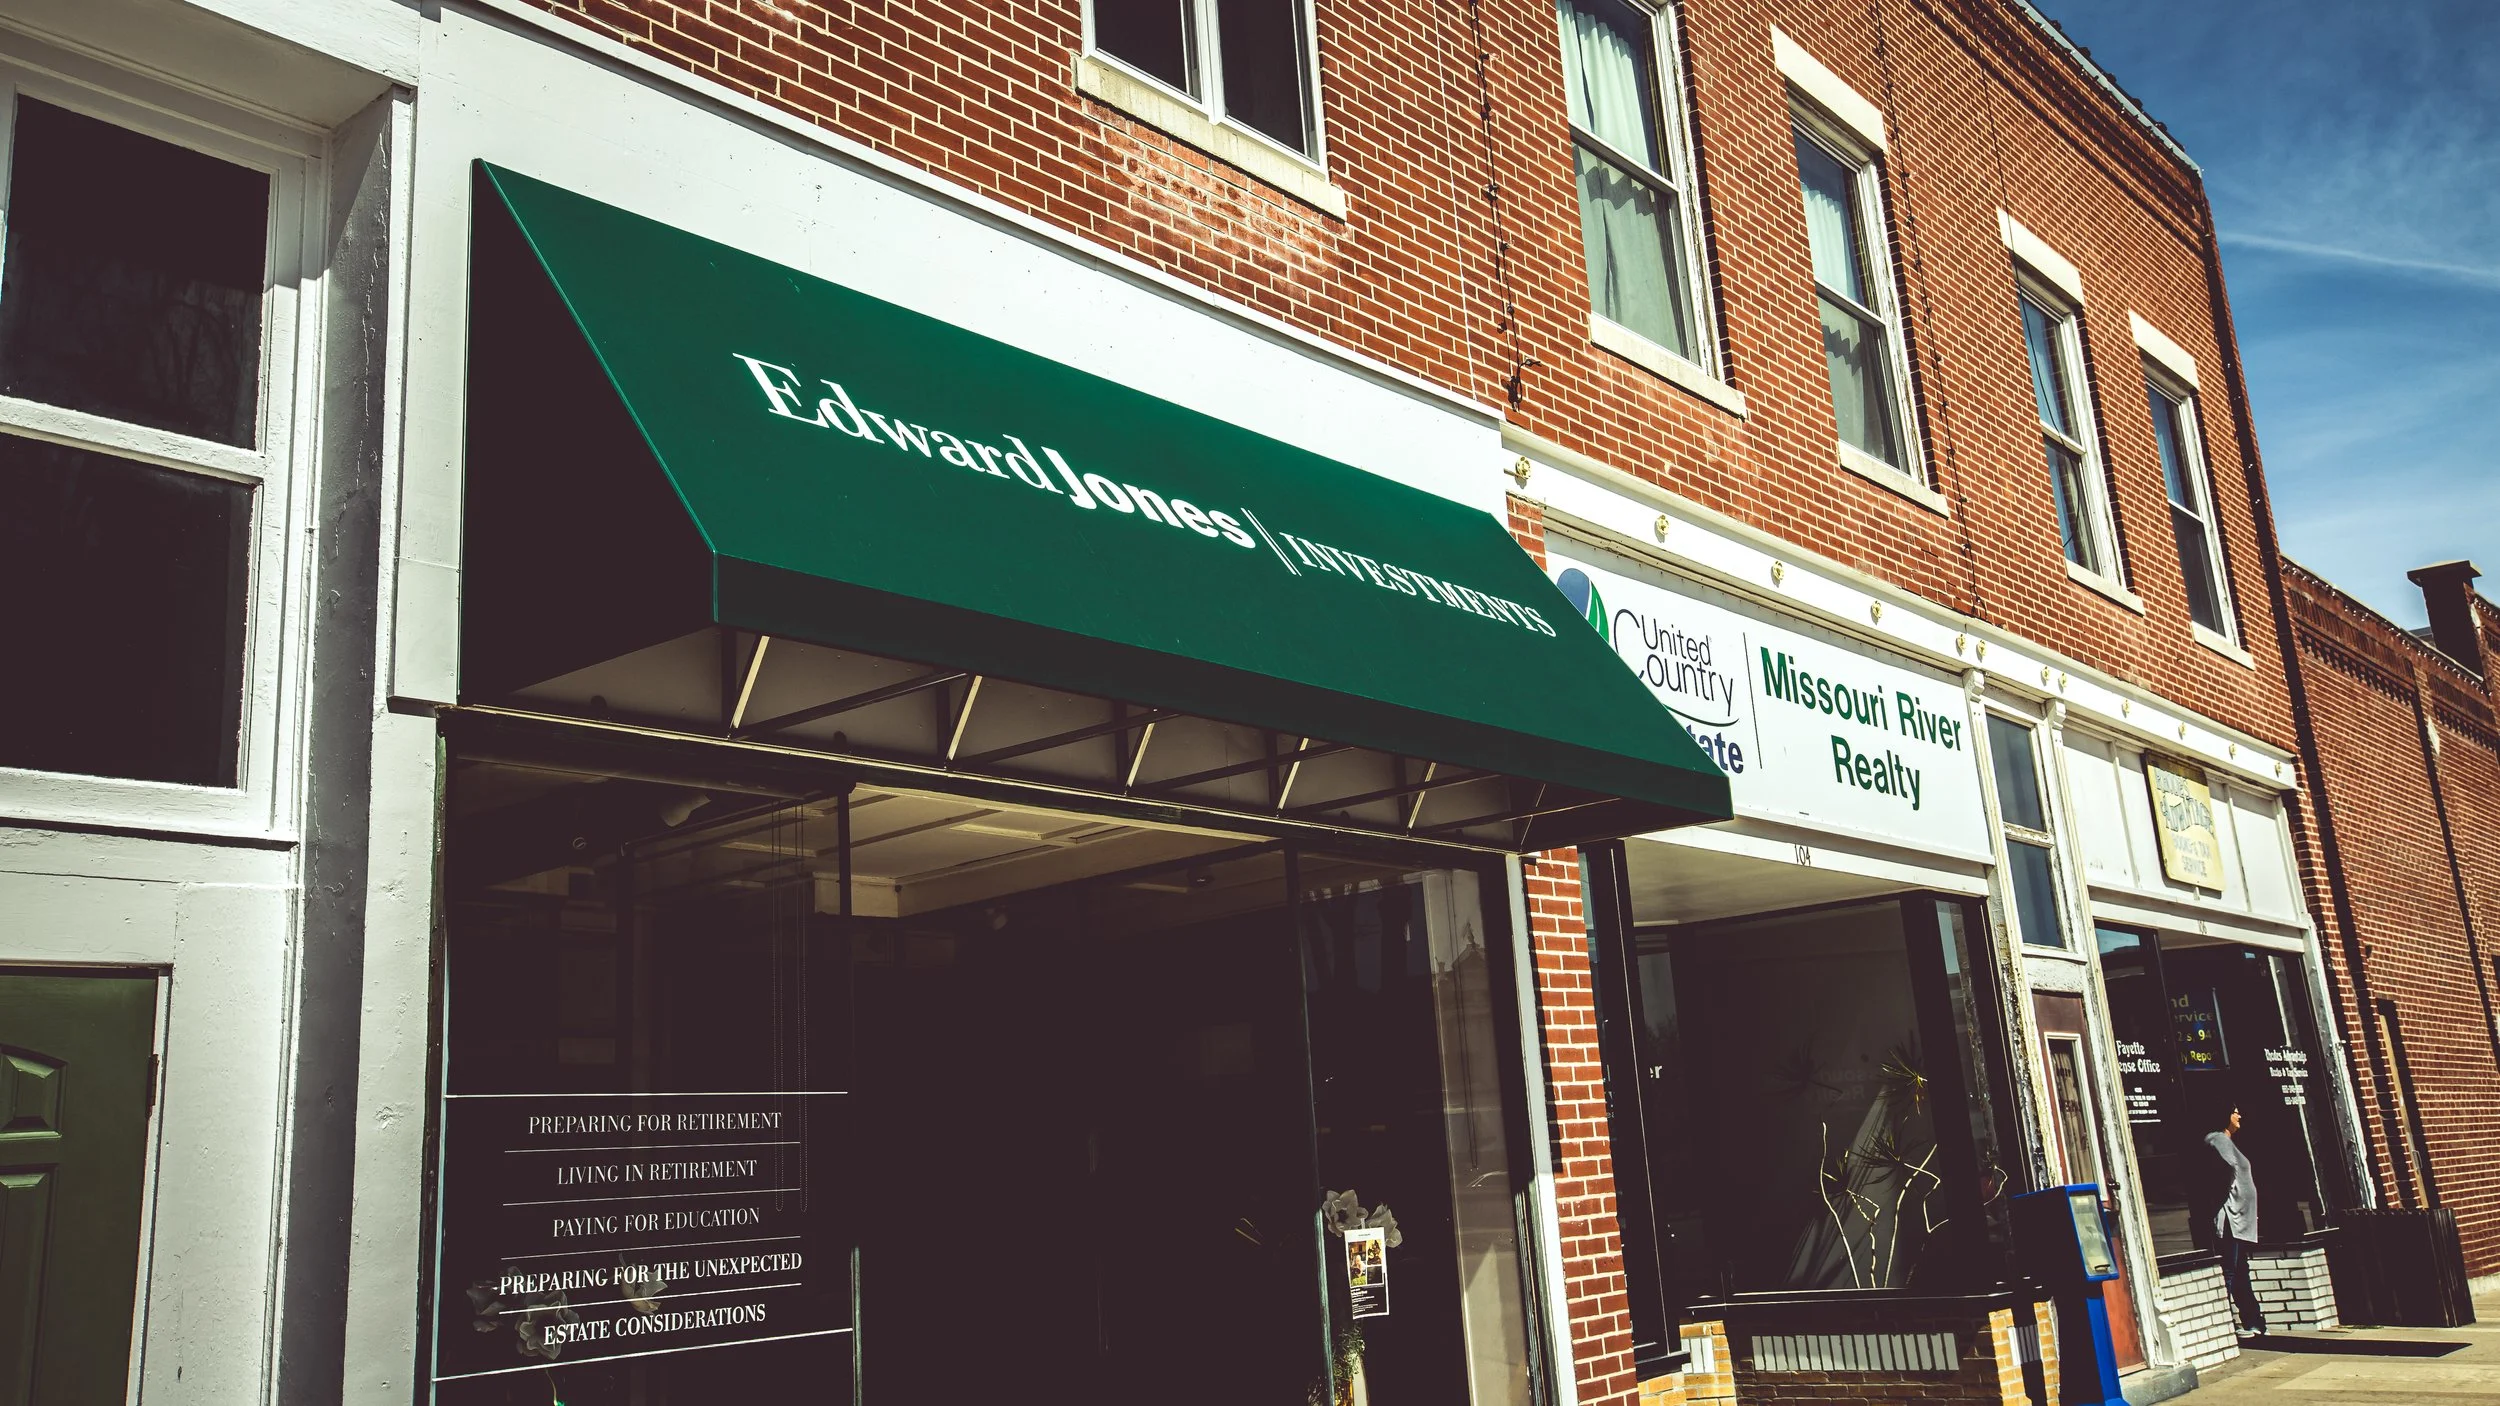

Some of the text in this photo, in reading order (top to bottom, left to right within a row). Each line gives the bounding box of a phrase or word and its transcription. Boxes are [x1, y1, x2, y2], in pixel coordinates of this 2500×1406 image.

[1278, 531, 1557, 637] INVESTMENTS
[1641, 614, 1712, 667] United
[1760, 646, 1961, 751] Missouri River
[1830, 734, 1920, 811] Realty
[1794, 843, 1811, 867] 104
[2115, 1040, 2146, 1058] Fayette
[2137, 1058, 2161, 1073] Office
[528, 1111, 782, 1135] PREPARING FOR RETIREMENT
[557, 1159, 758, 1186] LIVING IN RETIREMENT
[552, 1207, 761, 1238] PAYING FOR EDUCATION
[499, 1252, 802, 1296] PREPARING FOR THE UNEXPECTED
[543, 1303, 766, 1346] ESTATE CONSIDERATIONS
